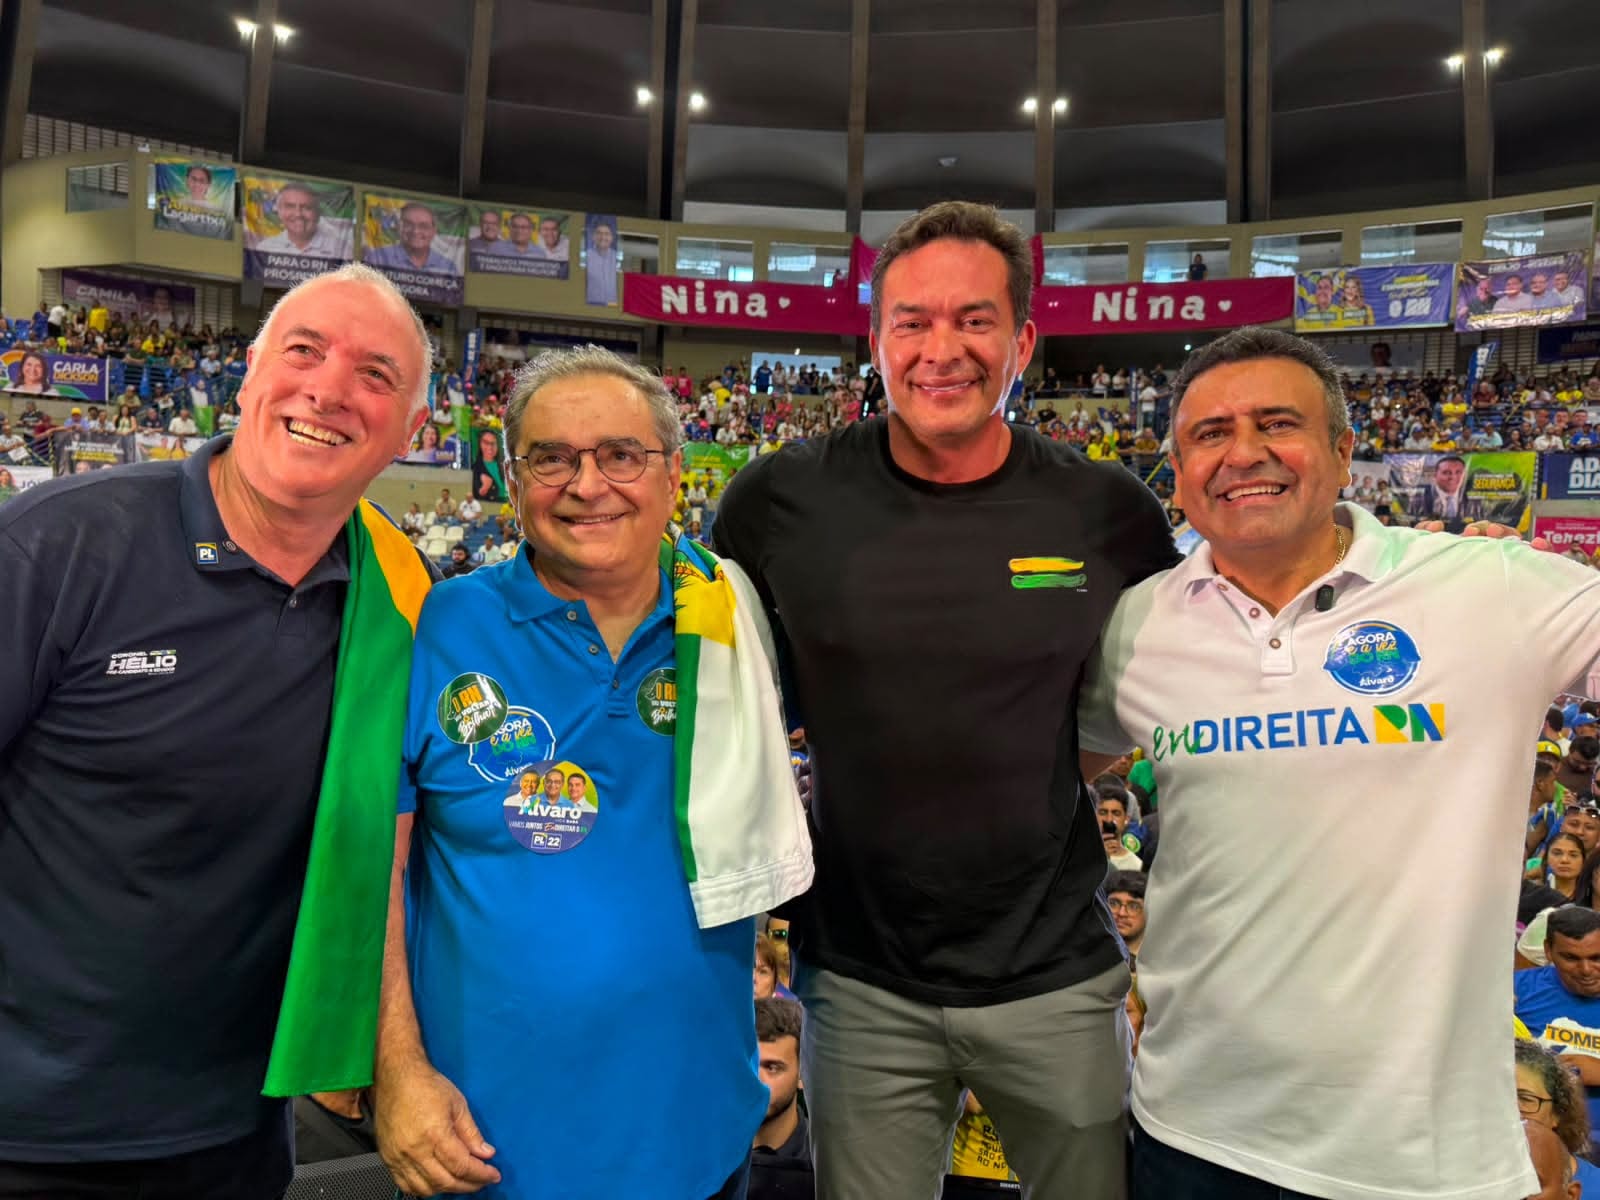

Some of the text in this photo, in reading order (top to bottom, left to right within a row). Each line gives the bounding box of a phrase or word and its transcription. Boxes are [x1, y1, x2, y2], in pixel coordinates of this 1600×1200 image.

[267, 255, 328, 270] PARA O RN
[76, 284, 137, 304] CAMILA
[661, 280, 768, 318] Nina
[1092, 286, 1206, 322] Nina
[53, 361, 99, 374] CARLA
[1570, 457, 1600, 473] AD
[200, 548, 215, 561] PL
[1347, 632, 1396, 646] AGORA
[534, 835, 561, 847] PL 22
